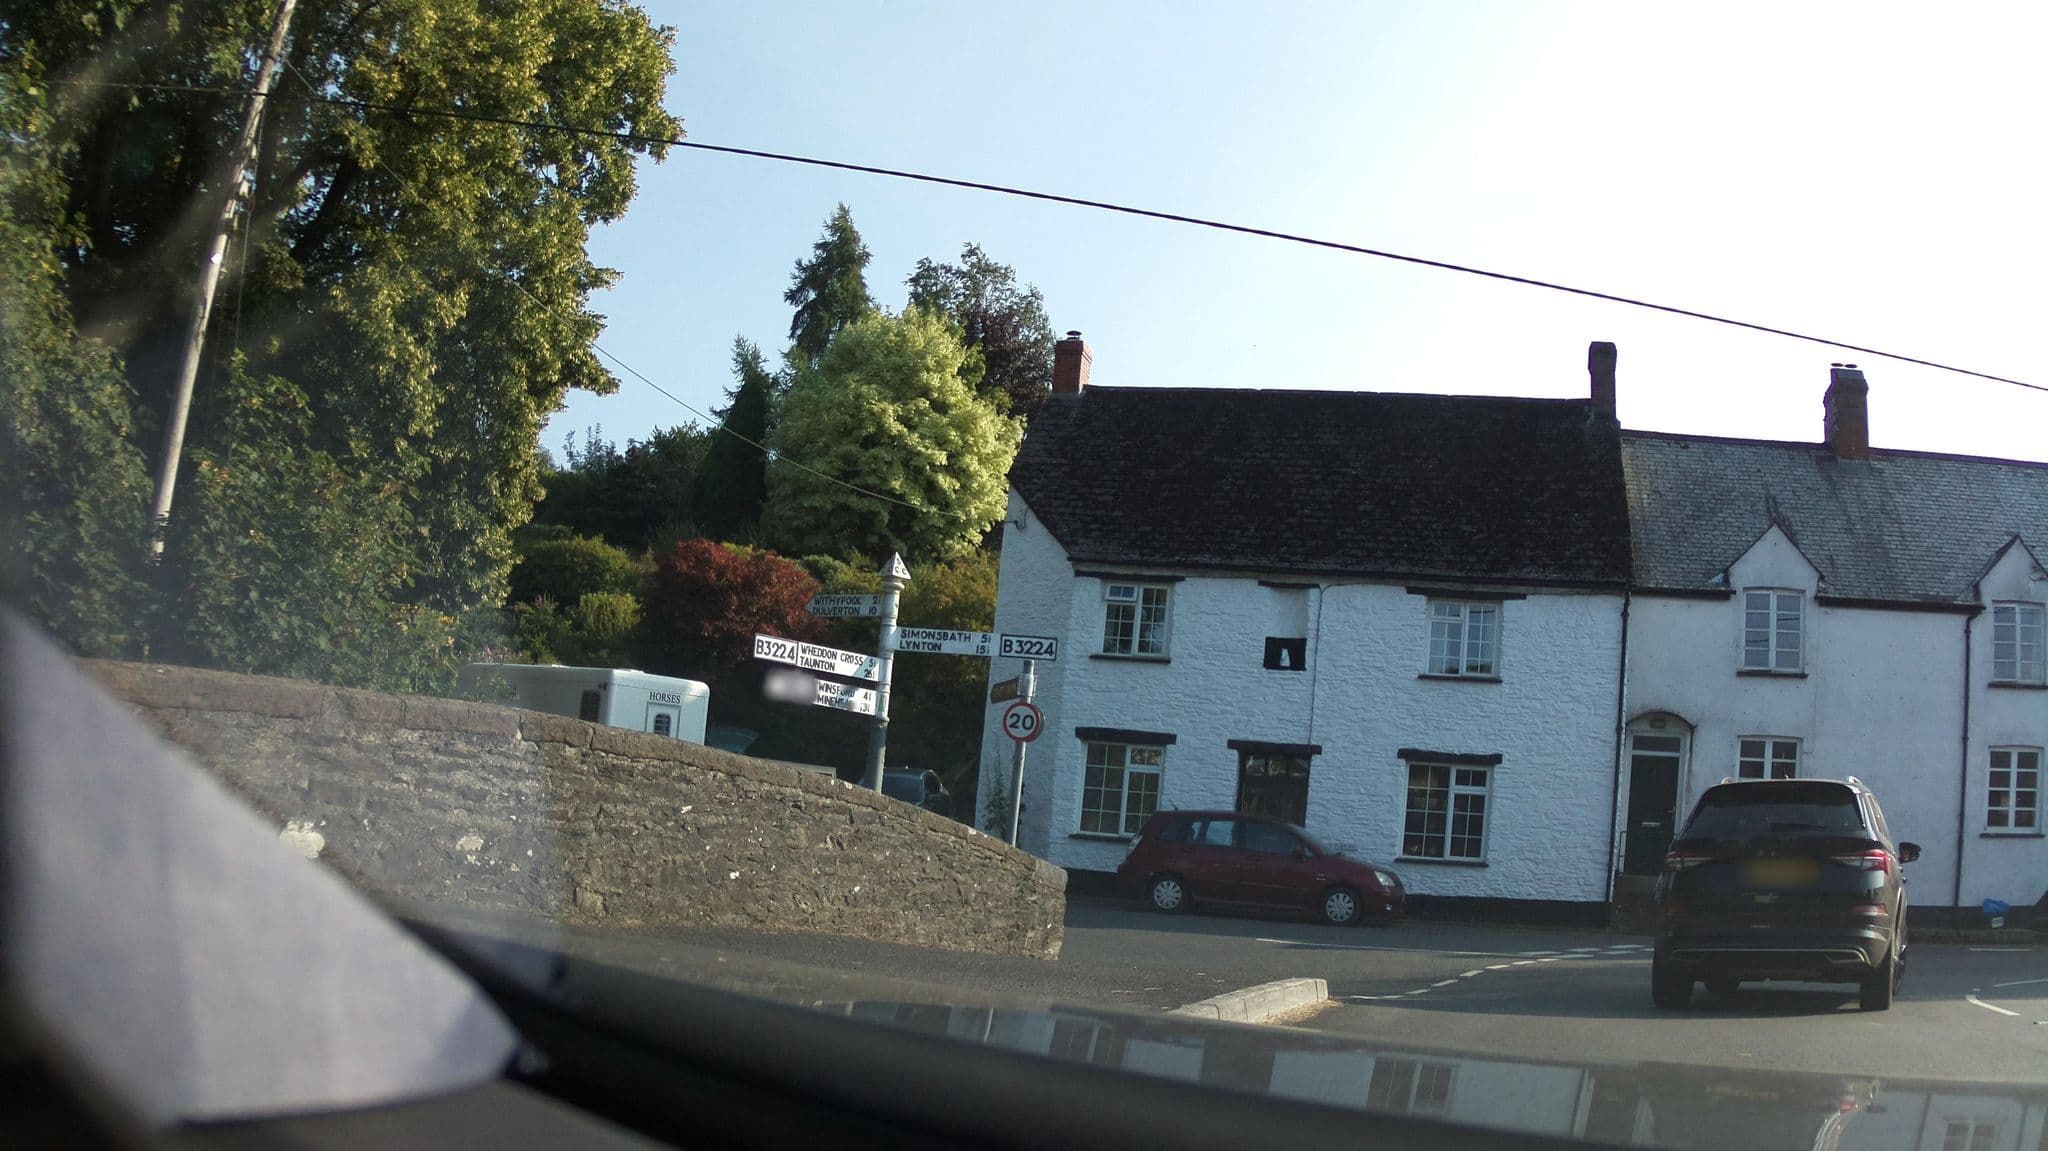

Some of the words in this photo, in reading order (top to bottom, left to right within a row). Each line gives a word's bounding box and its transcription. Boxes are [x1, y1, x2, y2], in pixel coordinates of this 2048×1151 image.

[814, 596, 862, 605] WITHYPOOL
[812, 606, 860, 616] DULVERTON
[868, 606, 877, 616] 10
[900, 628, 972, 643] SIMONSBATH
[755, 638, 796, 661] B3224
[899, 640, 942, 651] LYNTON
[1002, 639, 1055, 657] B3224
[800, 645, 838, 661] WHEDDON
[840, 652, 864, 666] CROSS
[799, 656, 836, 672] TAUNTON
[649, 691, 681, 704] HORSES
[818, 681, 856, 698] WINSFORD
[1008, 713, 1035, 731] 20
